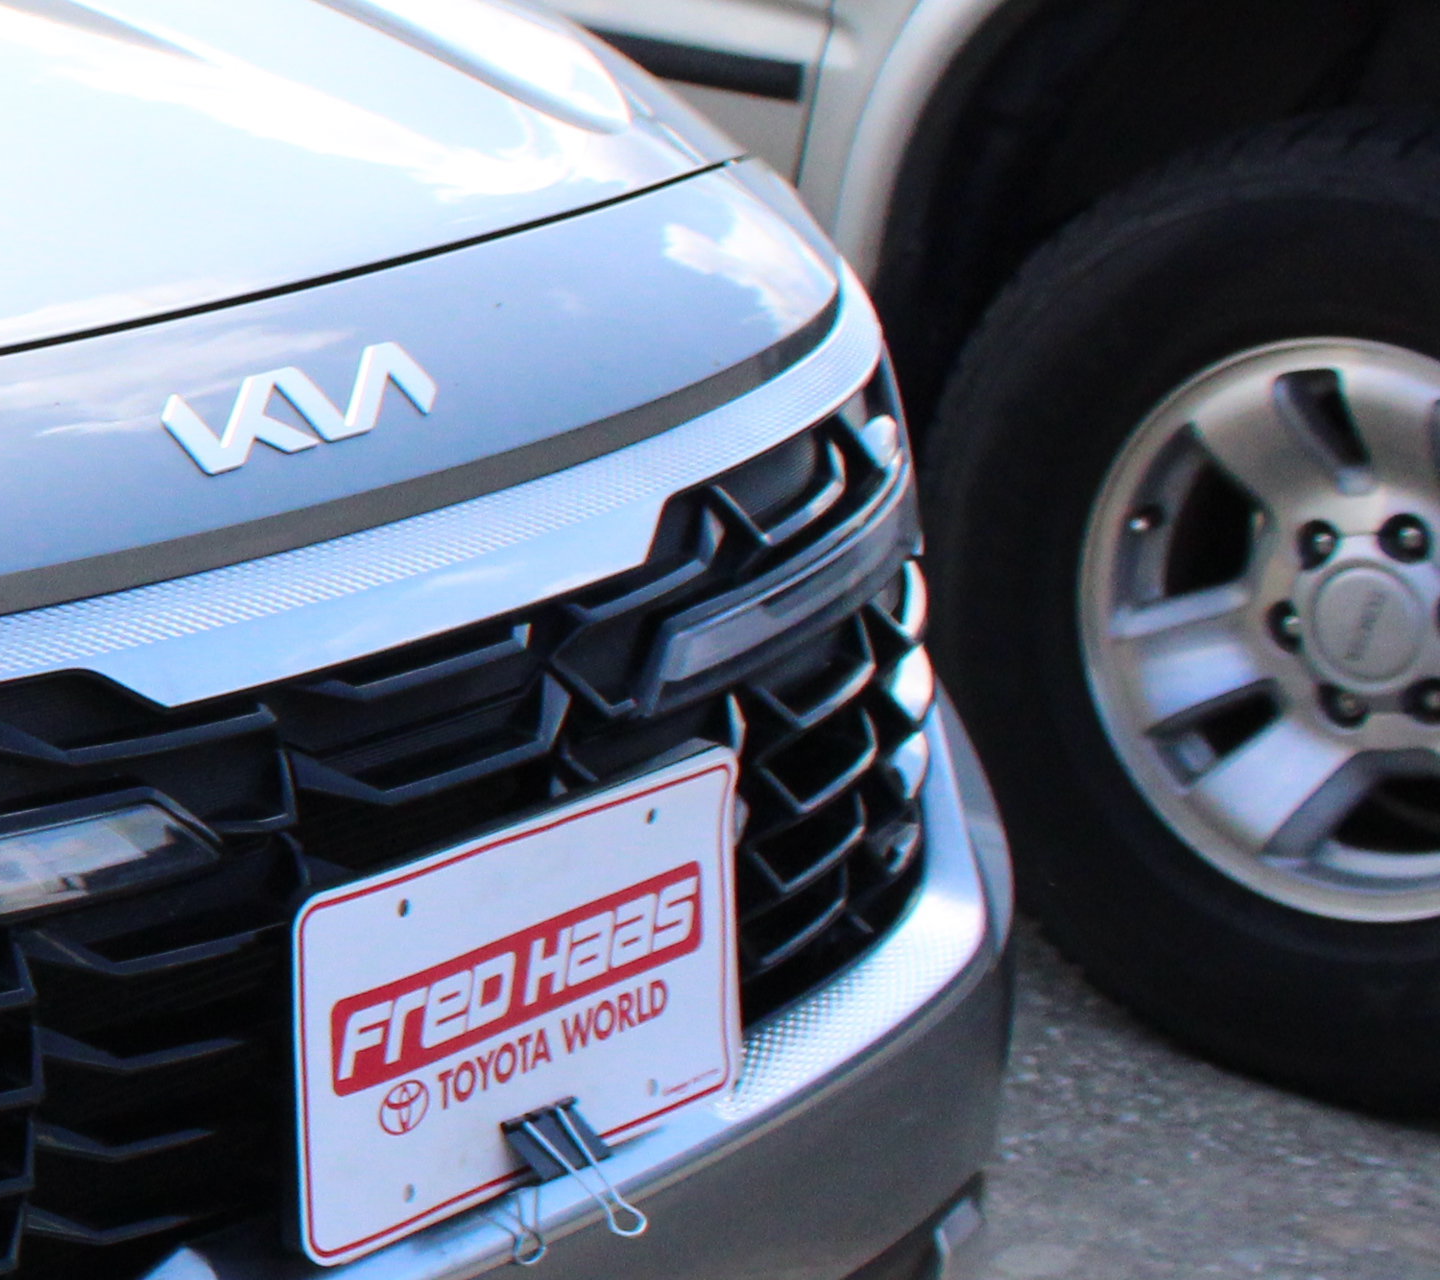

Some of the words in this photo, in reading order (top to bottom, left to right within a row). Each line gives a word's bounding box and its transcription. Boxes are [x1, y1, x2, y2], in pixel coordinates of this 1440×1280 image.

[162, 342, 438, 477] KIA
[439, 1036, 551, 1109] TOYOTA
[562, 979, 668, 1055] WORLD
